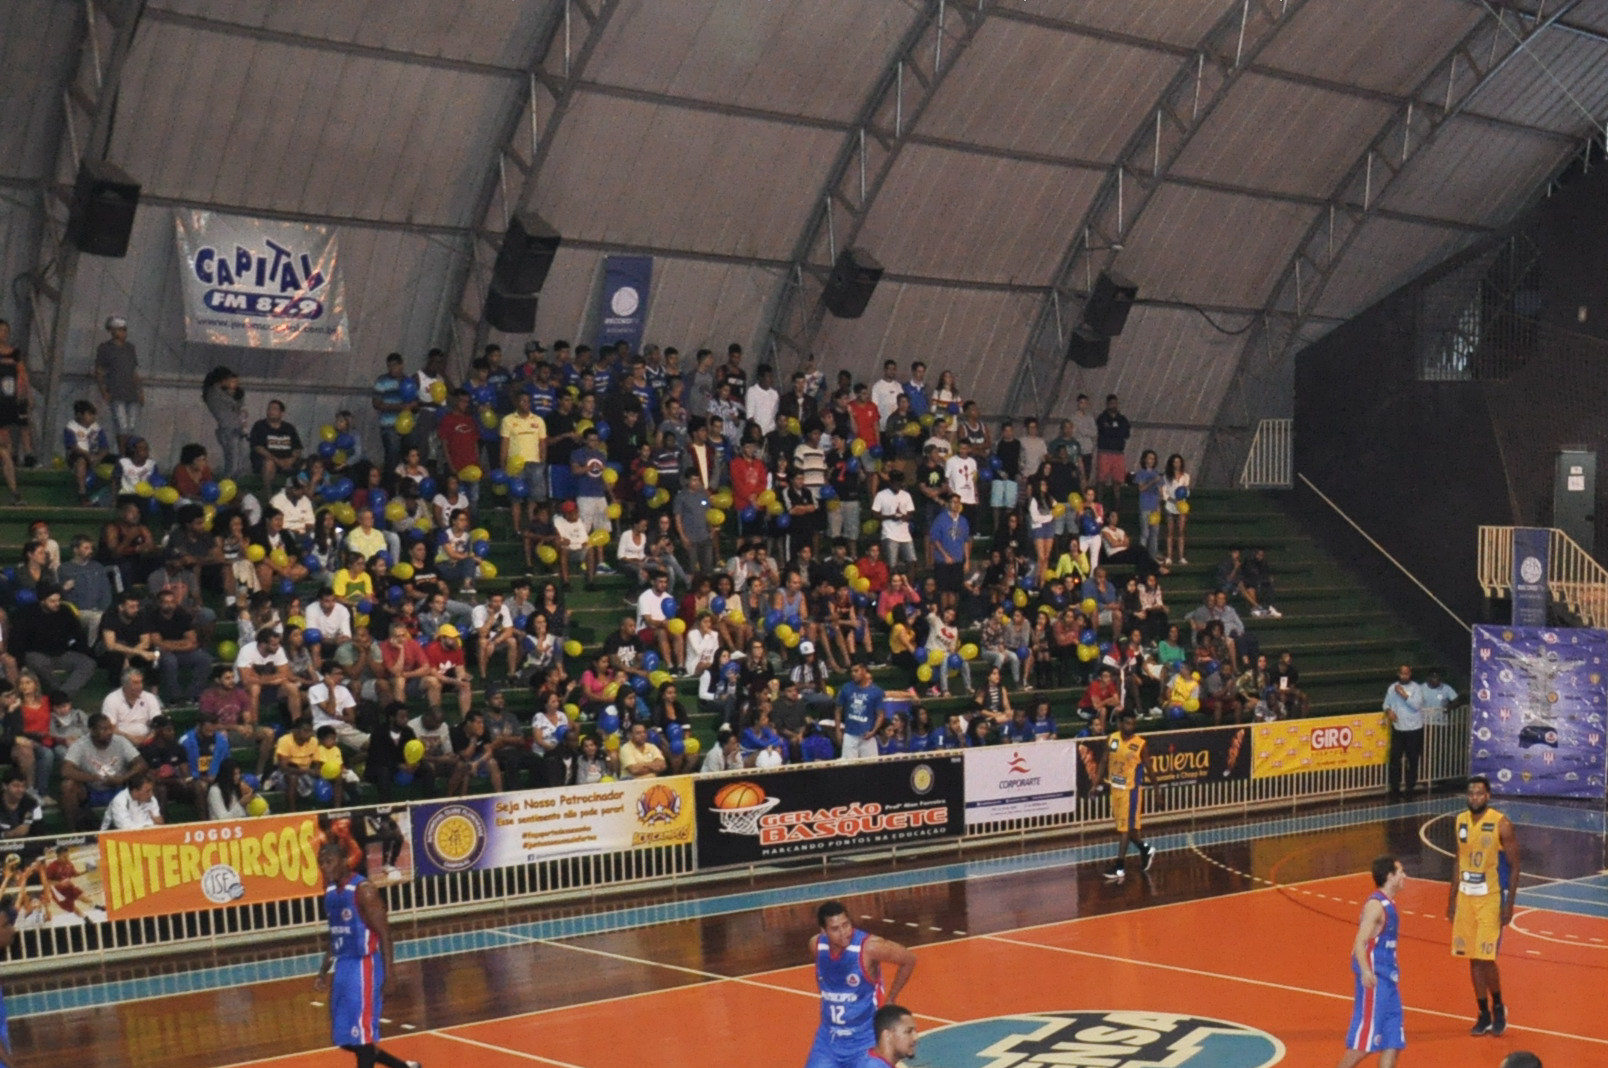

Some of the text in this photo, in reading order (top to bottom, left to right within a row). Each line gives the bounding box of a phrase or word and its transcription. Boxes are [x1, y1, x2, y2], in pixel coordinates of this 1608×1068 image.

[194, 239, 326, 293] CAPITAL
[211, 291, 318, 315] FM 87.9
[1312, 728, 1352, 749] GIRO
[496, 790, 625, 814] Seja Nosso Patrocinador
[760, 802, 882, 827] GERAÇÃO
[760, 807, 948, 845] BASQUETE
[184, 826, 243, 844] JOGOS
[762, 827, 947, 855] MARCANDO PONTOS NA EDUCAÇÃO
[106, 819, 319, 911] INTERCURSOS
[830, 1004, 846, 1025] 12
